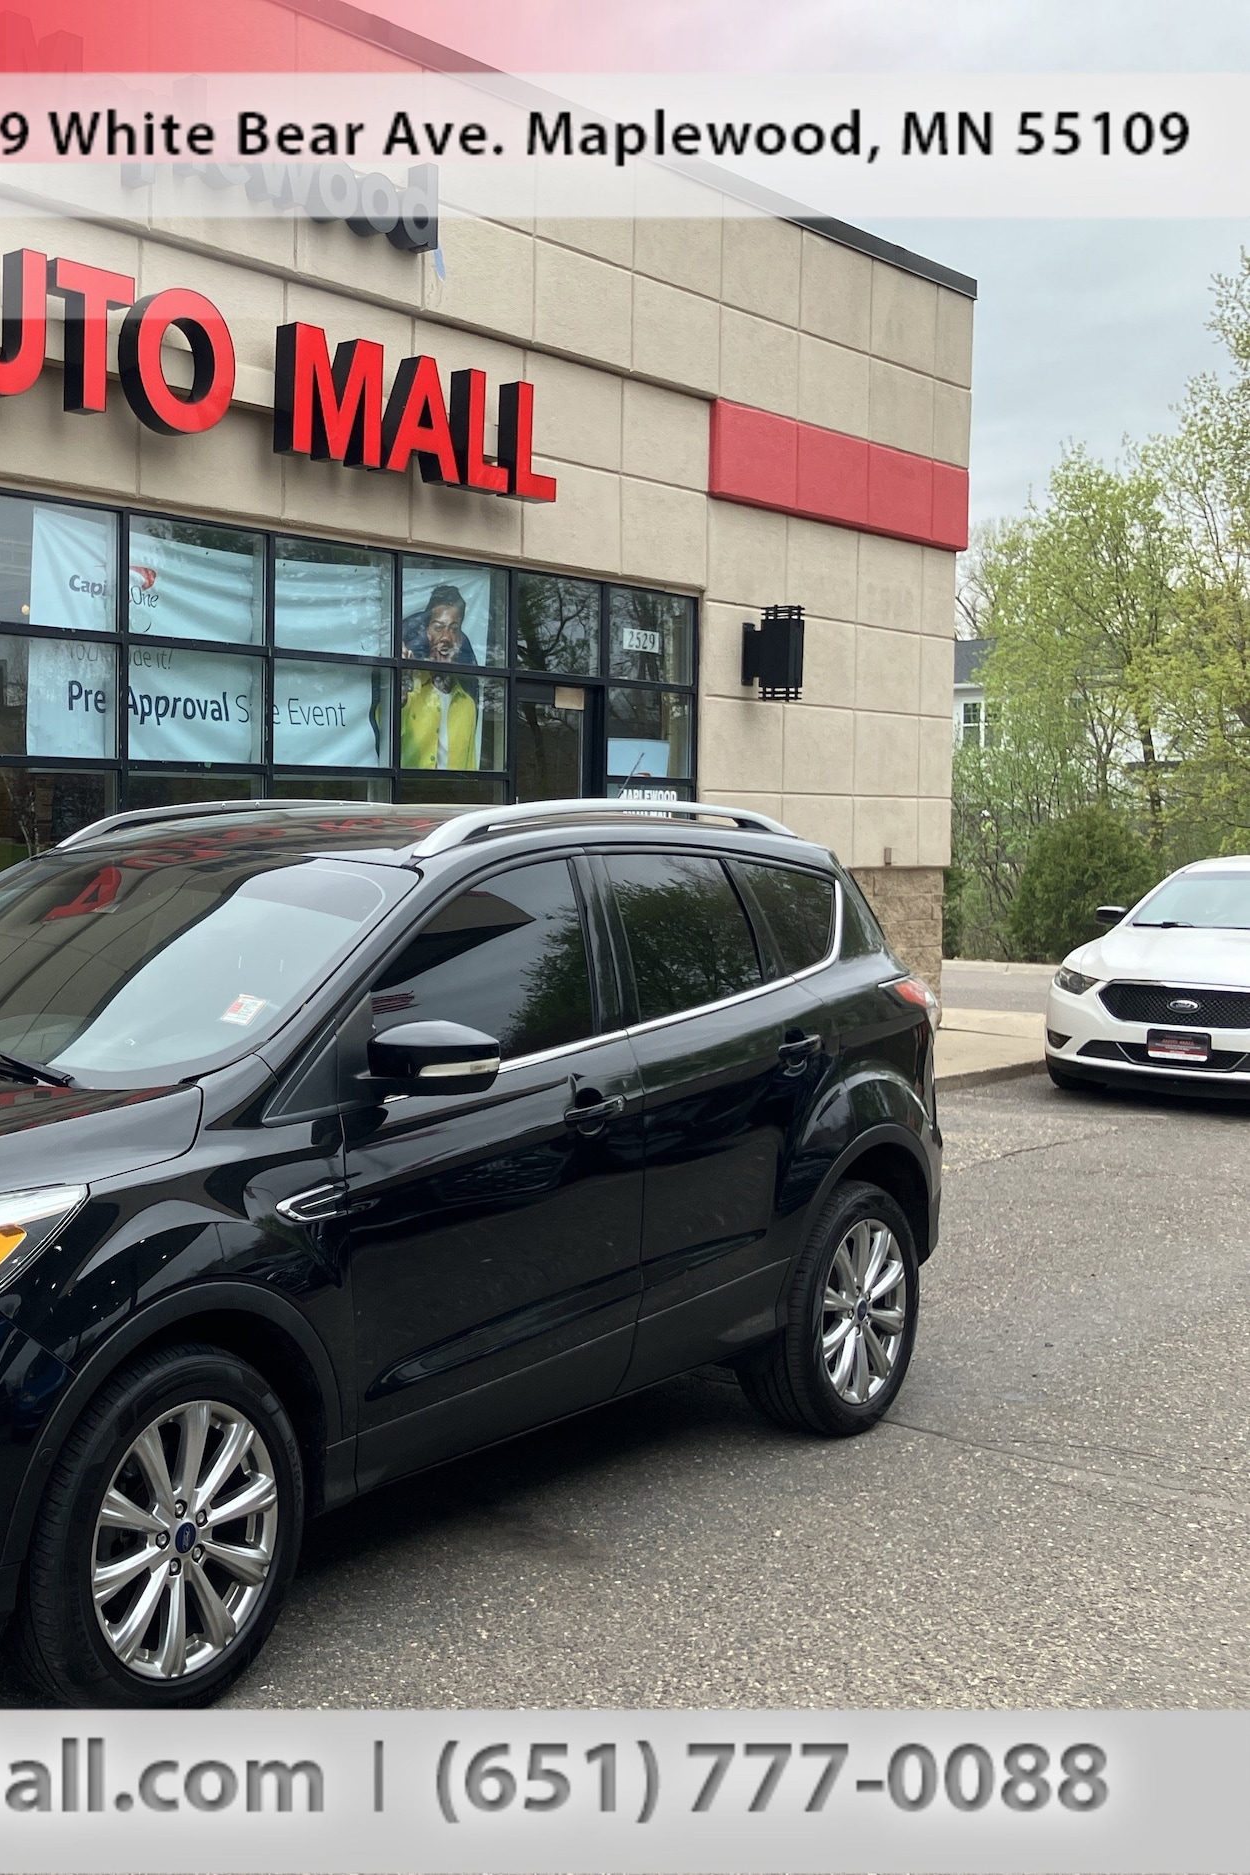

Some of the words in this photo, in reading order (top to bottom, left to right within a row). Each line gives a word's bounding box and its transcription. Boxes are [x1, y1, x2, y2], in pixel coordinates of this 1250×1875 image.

[273, 321, 557, 503] MALL
[130, 585, 159, 608] One
[627, 630, 656, 650] 2529
[68, 680, 230, 726] PreApproval
[288, 698, 347, 727] Event
